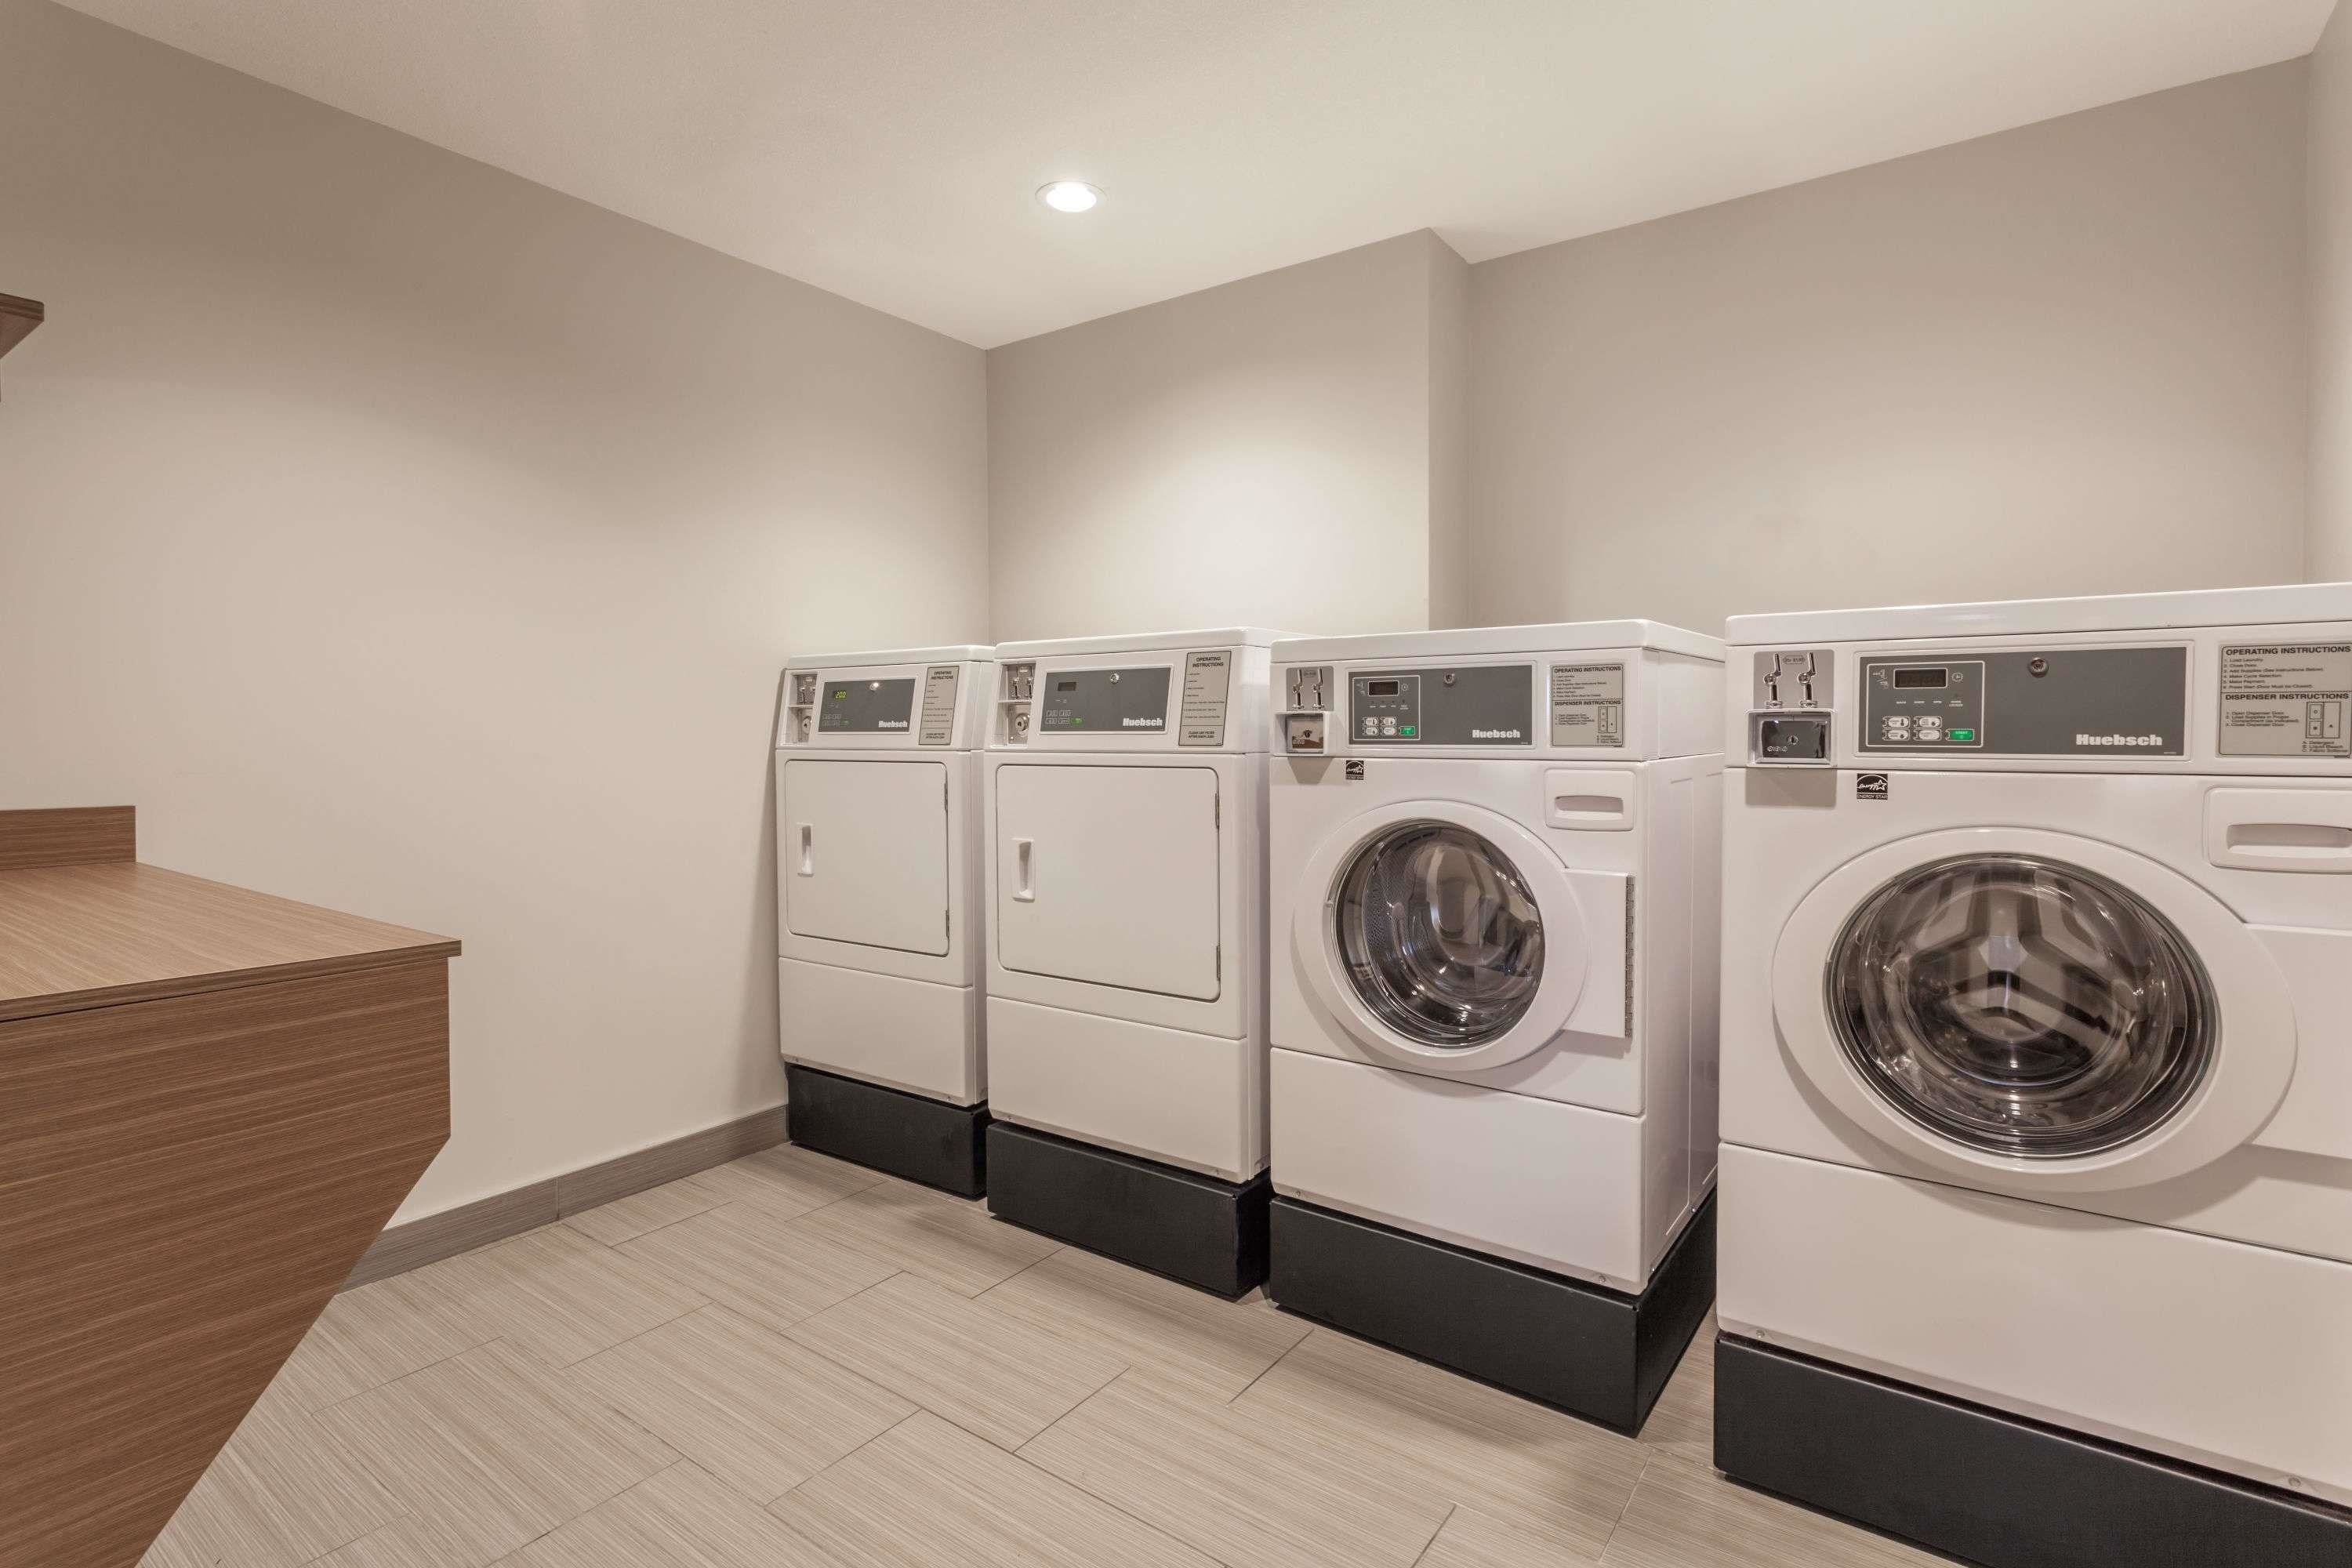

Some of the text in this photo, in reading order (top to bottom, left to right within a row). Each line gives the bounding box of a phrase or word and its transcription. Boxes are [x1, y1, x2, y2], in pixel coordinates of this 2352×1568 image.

[2281, 646, 2351, 654] INSTRUCTIONS
[1123, 718, 1163, 726] Huebsch
[1472, 730, 1520, 738] Huebsch
[2076, 734, 2163, 746] Huebsch
